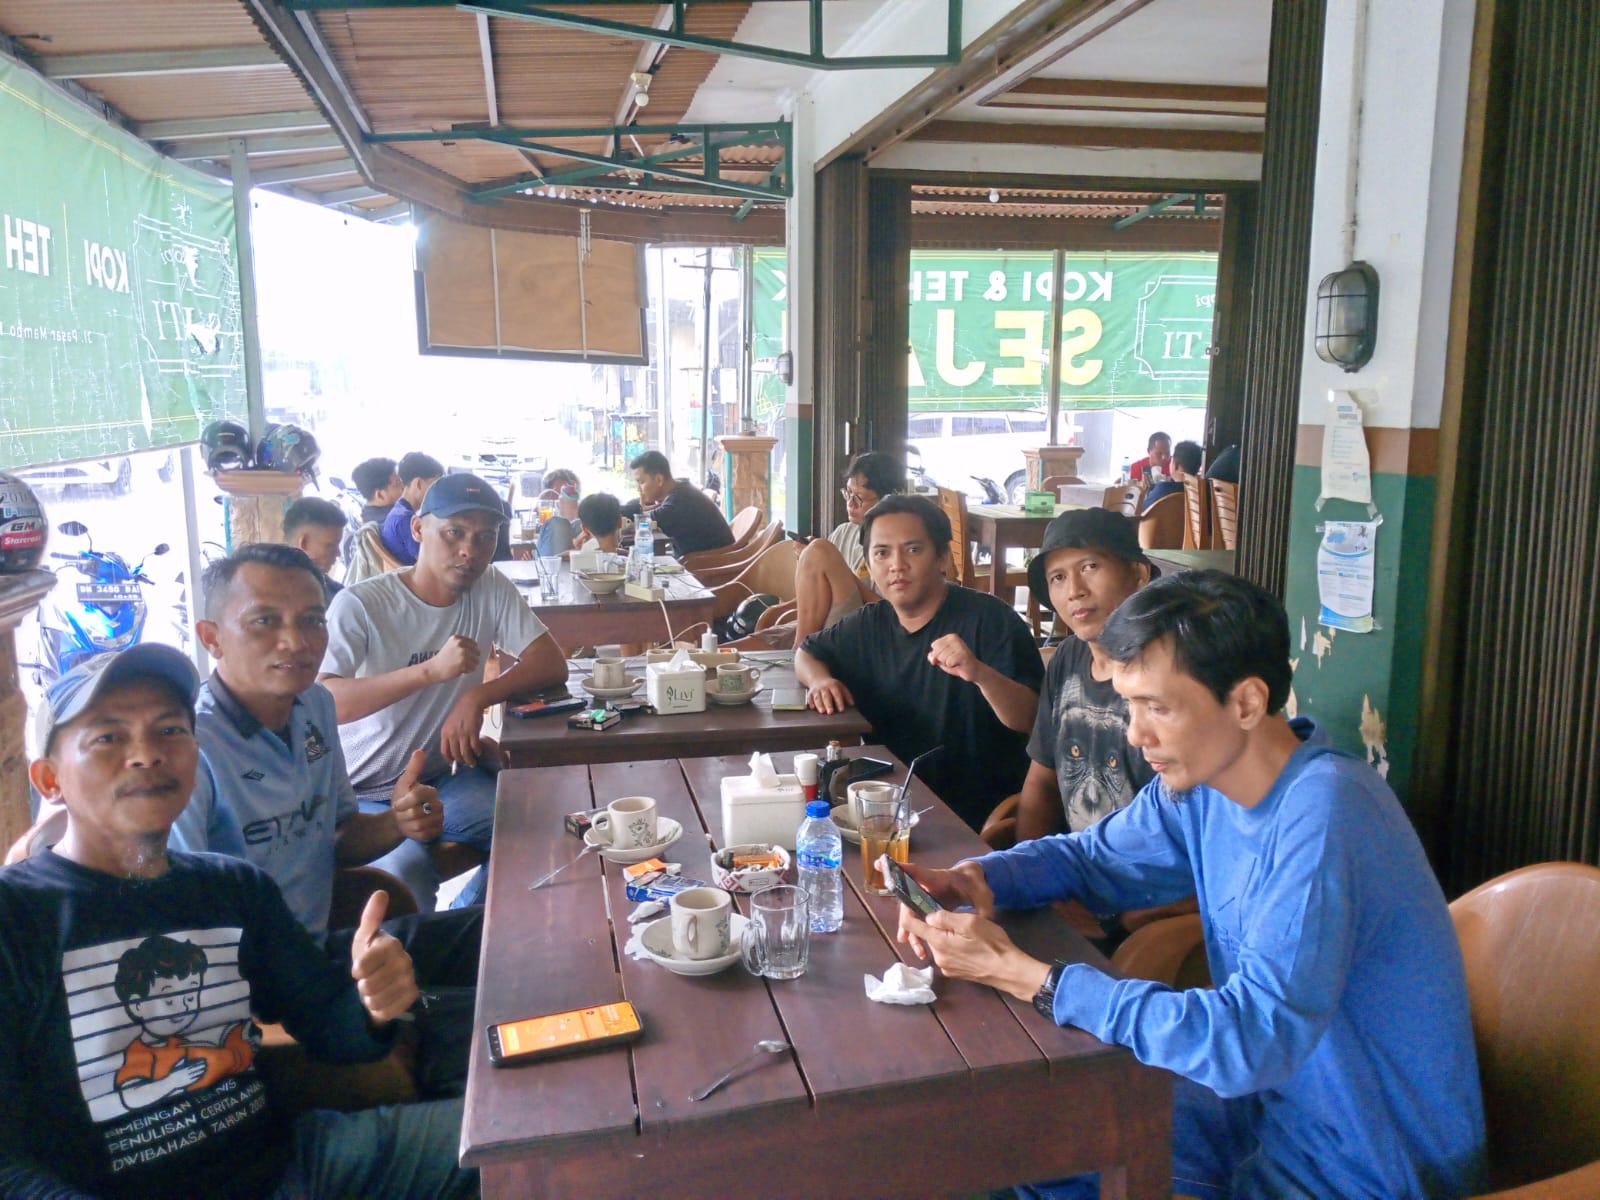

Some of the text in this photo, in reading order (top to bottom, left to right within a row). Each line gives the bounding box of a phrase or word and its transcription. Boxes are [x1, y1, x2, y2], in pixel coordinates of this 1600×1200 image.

[11, 521, 35, 532] GM
[108, 1114, 197, 1153] PENULISAN
[200, 1097, 239, 1119] CERITA
[112, 1129, 208, 1173] DWIBAHASA
[211, 1107, 248, 1133] TAHUN
